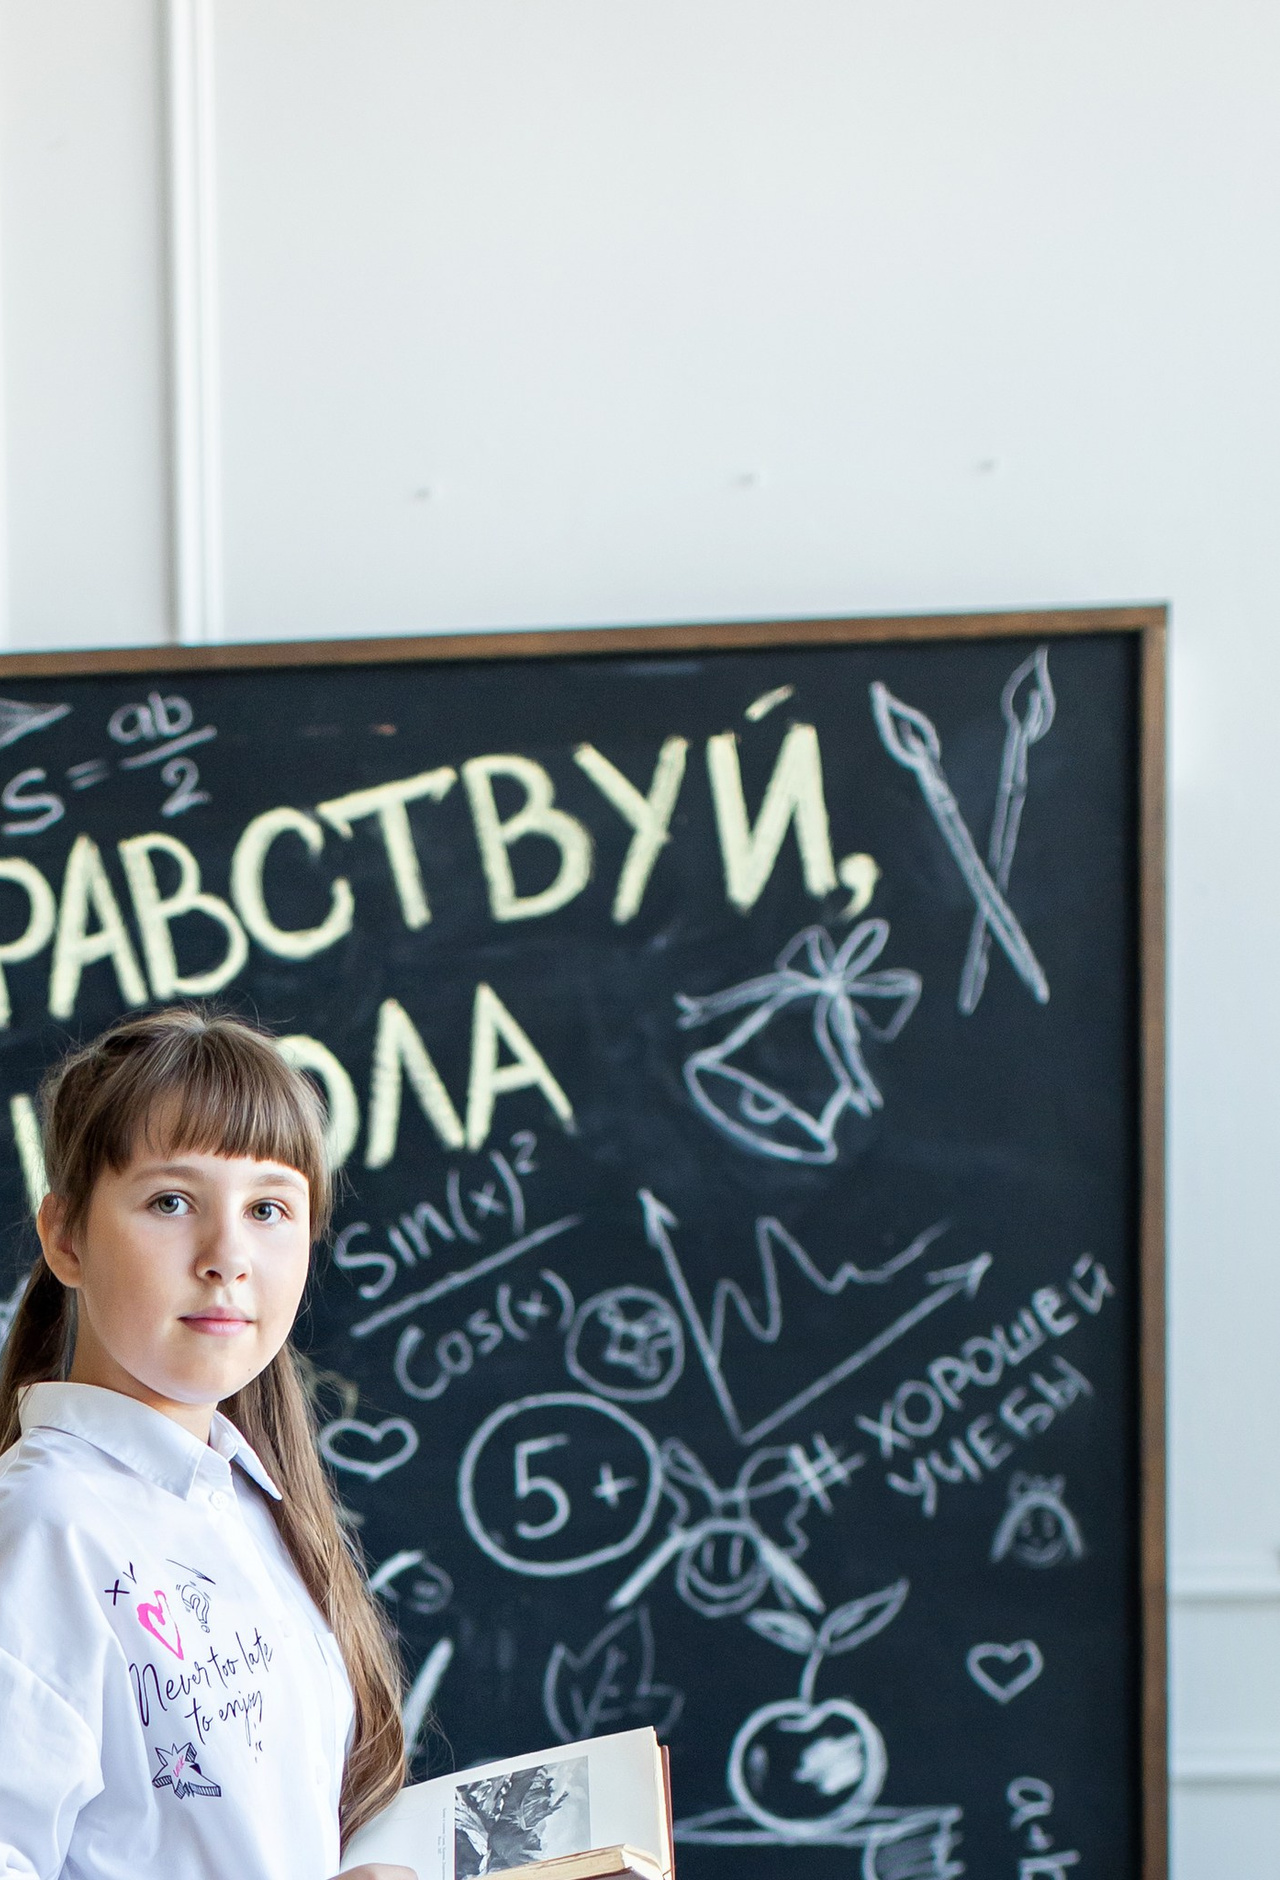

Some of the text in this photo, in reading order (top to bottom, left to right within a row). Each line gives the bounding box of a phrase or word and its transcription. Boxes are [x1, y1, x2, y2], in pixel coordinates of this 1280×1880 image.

[129, 1627, 274, 1727] Never too late
[184, 1690, 263, 1747] to enjoy
